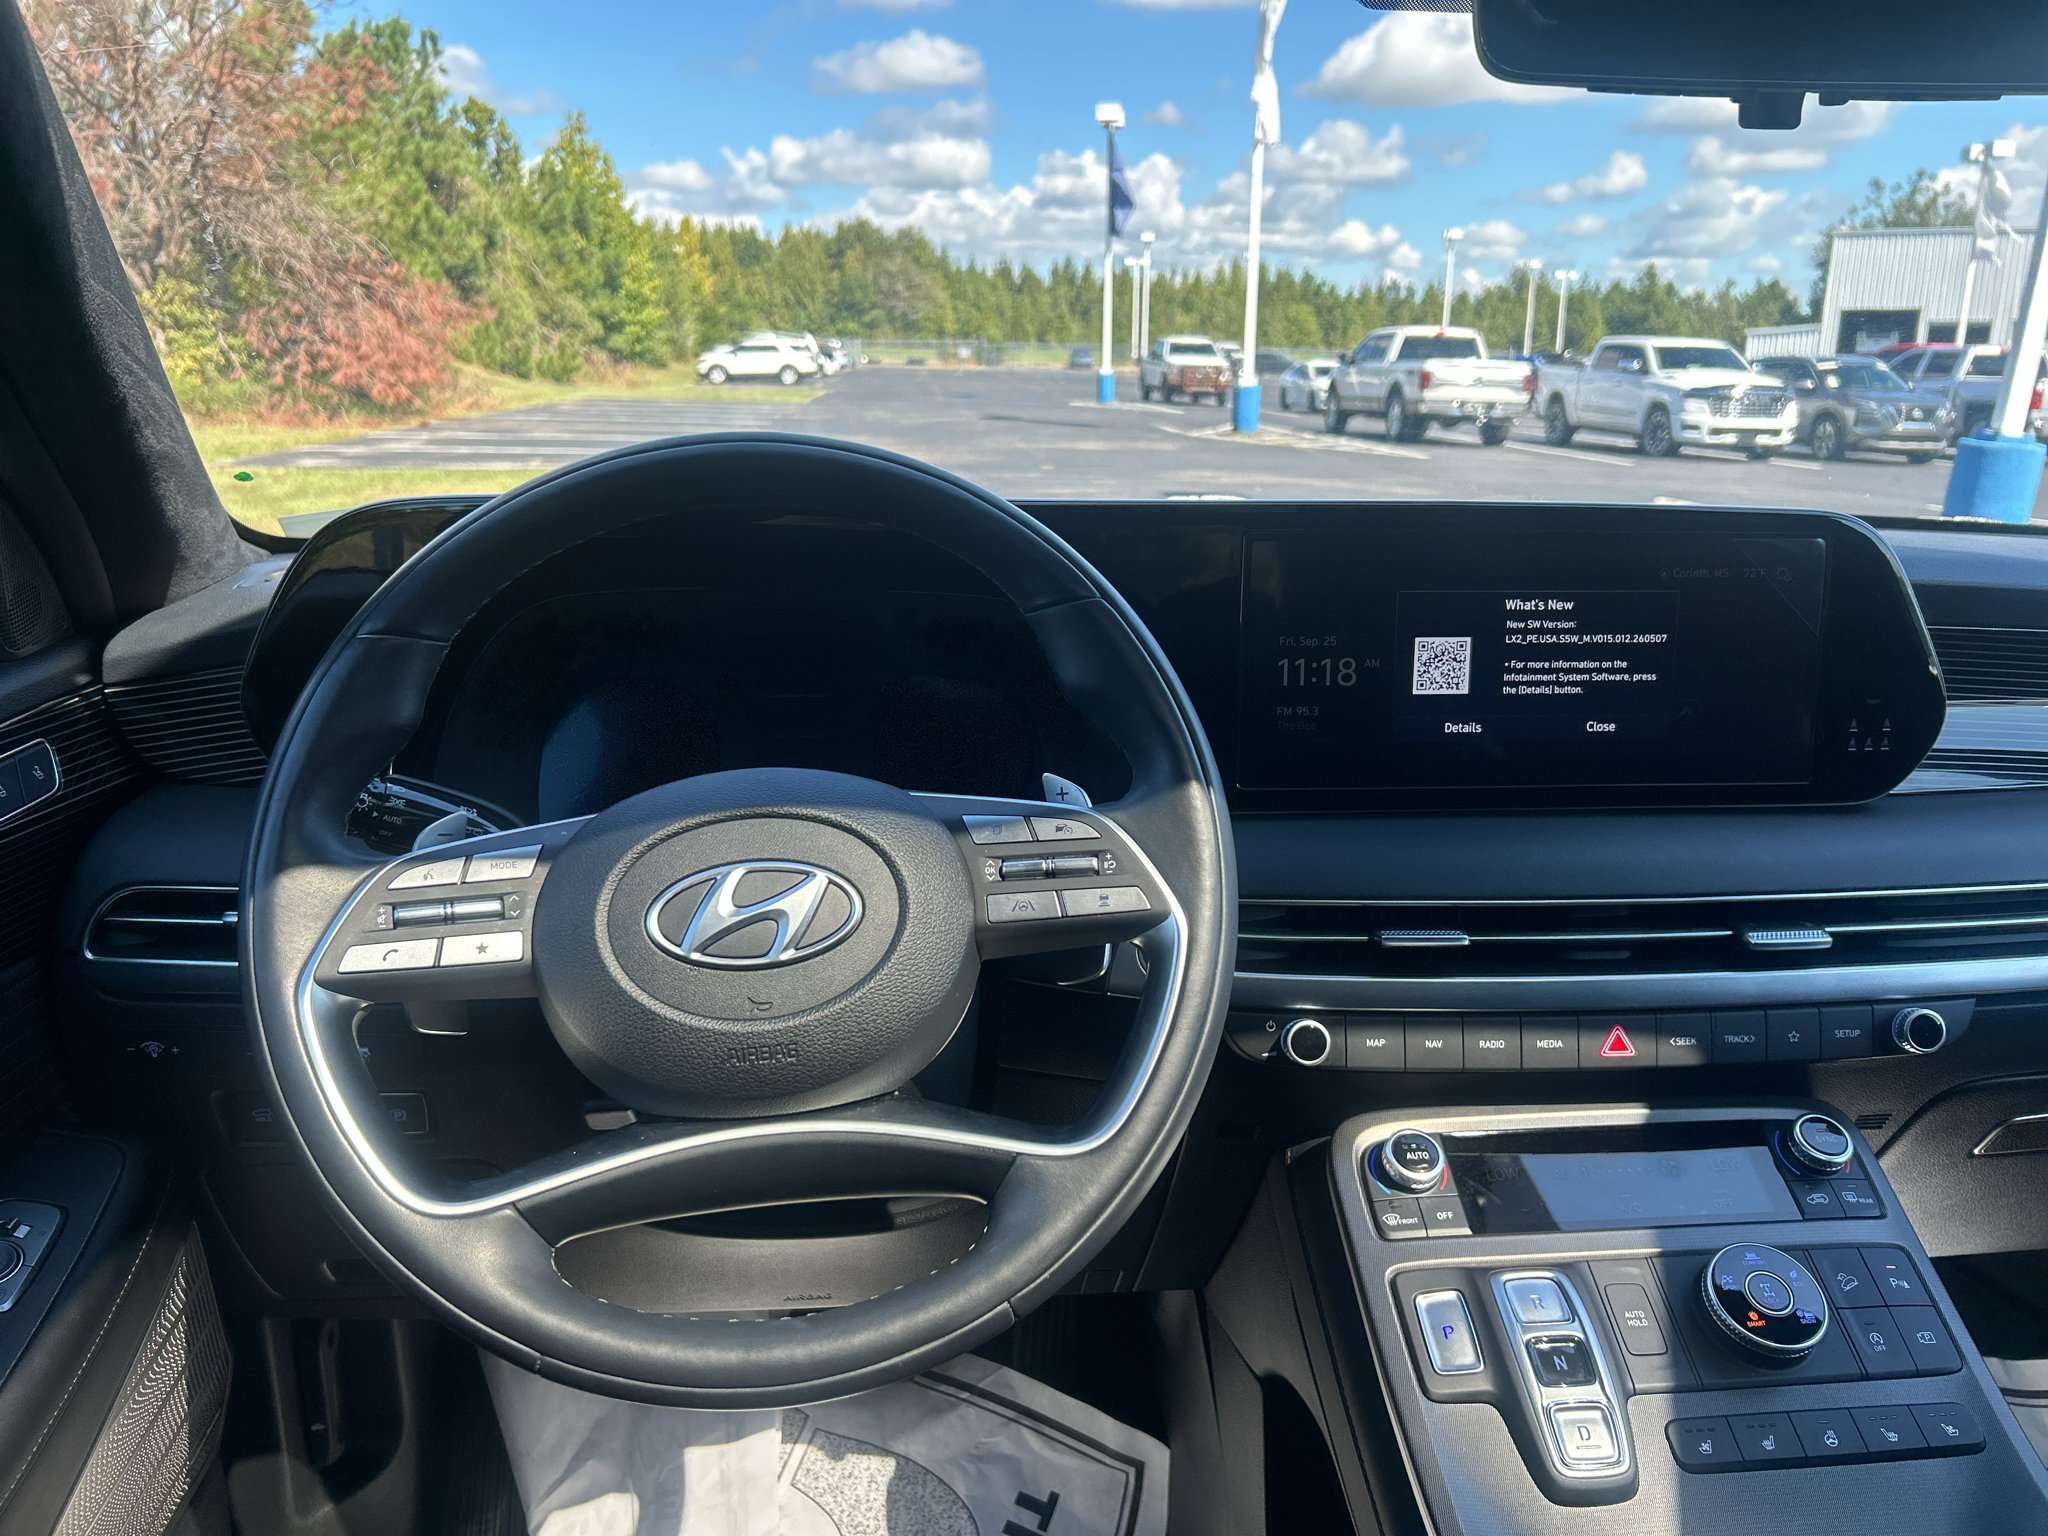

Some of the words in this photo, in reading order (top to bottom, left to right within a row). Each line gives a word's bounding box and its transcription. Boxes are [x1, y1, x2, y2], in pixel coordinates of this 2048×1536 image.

[1505, 599, 1545, 611] What's
[1547, 599, 1574, 611] New
[1506, 620, 1526, 629] New
[1526, 620, 1542, 629] SW
[1542, 620, 1577, 629] Version:
[1298, 635, 1321, 648] Sep.
[1323, 635, 1337, 646] 25
[1510, 660, 1526, 669] For
[1527, 661, 1549, 669] more
[1551, 660, 1600, 669] information
[1601, 661, 1612, 669] on
[1613, 660, 1628, 669] the
[1277, 657, 1358, 687] 11:18
[1363, 657, 1381, 668] AM
[1503, 673, 1557, 682] Infotainment
[1558, 673, 1590, 683] System
[1591, 673, 1631, 682] Software,
[1633, 674, 1657, 683] press
[1502, 686, 1517, 695] the
[1518, 685, 1553, 695] [Details]
[1554, 686, 1584, 695] button.
[1276, 705, 1293, 717] FM
[1296, 705, 1320, 717] 95.3
[1444, 721, 1482, 733] Details
[1586, 721, 1616, 732] Close
[382, 814, 402, 826] AUTO
[490, 861, 518, 871] MODE
[984, 866, 996, 874] OK
[1834, 1029, 1860, 1039] SETUP
[1366, 1038, 1386, 1048] MAP
[1425, 1039, 1443, 1049] NAV
[1479, 1039, 1505, 1049] RADIO
[1536, 1039, 1563, 1049] MEDIA
[726, 1042, 800, 1067] AIRBAG
[1815, 1135, 1838, 1144] SYNC
[1406, 1150, 1430, 1160] AUTO
[1398, 1217, 1419, 1225] FRONT
[1436, 1211, 1455, 1221] OFF
[783, 1292, 833, 1302] AIRBAG
[1529, 1294, 1545, 1310] R
[1624, 1310, 1645, 1319] AUTO
[1627, 1318, 1649, 1327] HOLD
[1746, 1320, 1766, 1328] SMART
[1441, 1325, 1455, 1341] P
[1552, 1355, 1569, 1371] N
[1576, 1425, 1592, 1442] D
